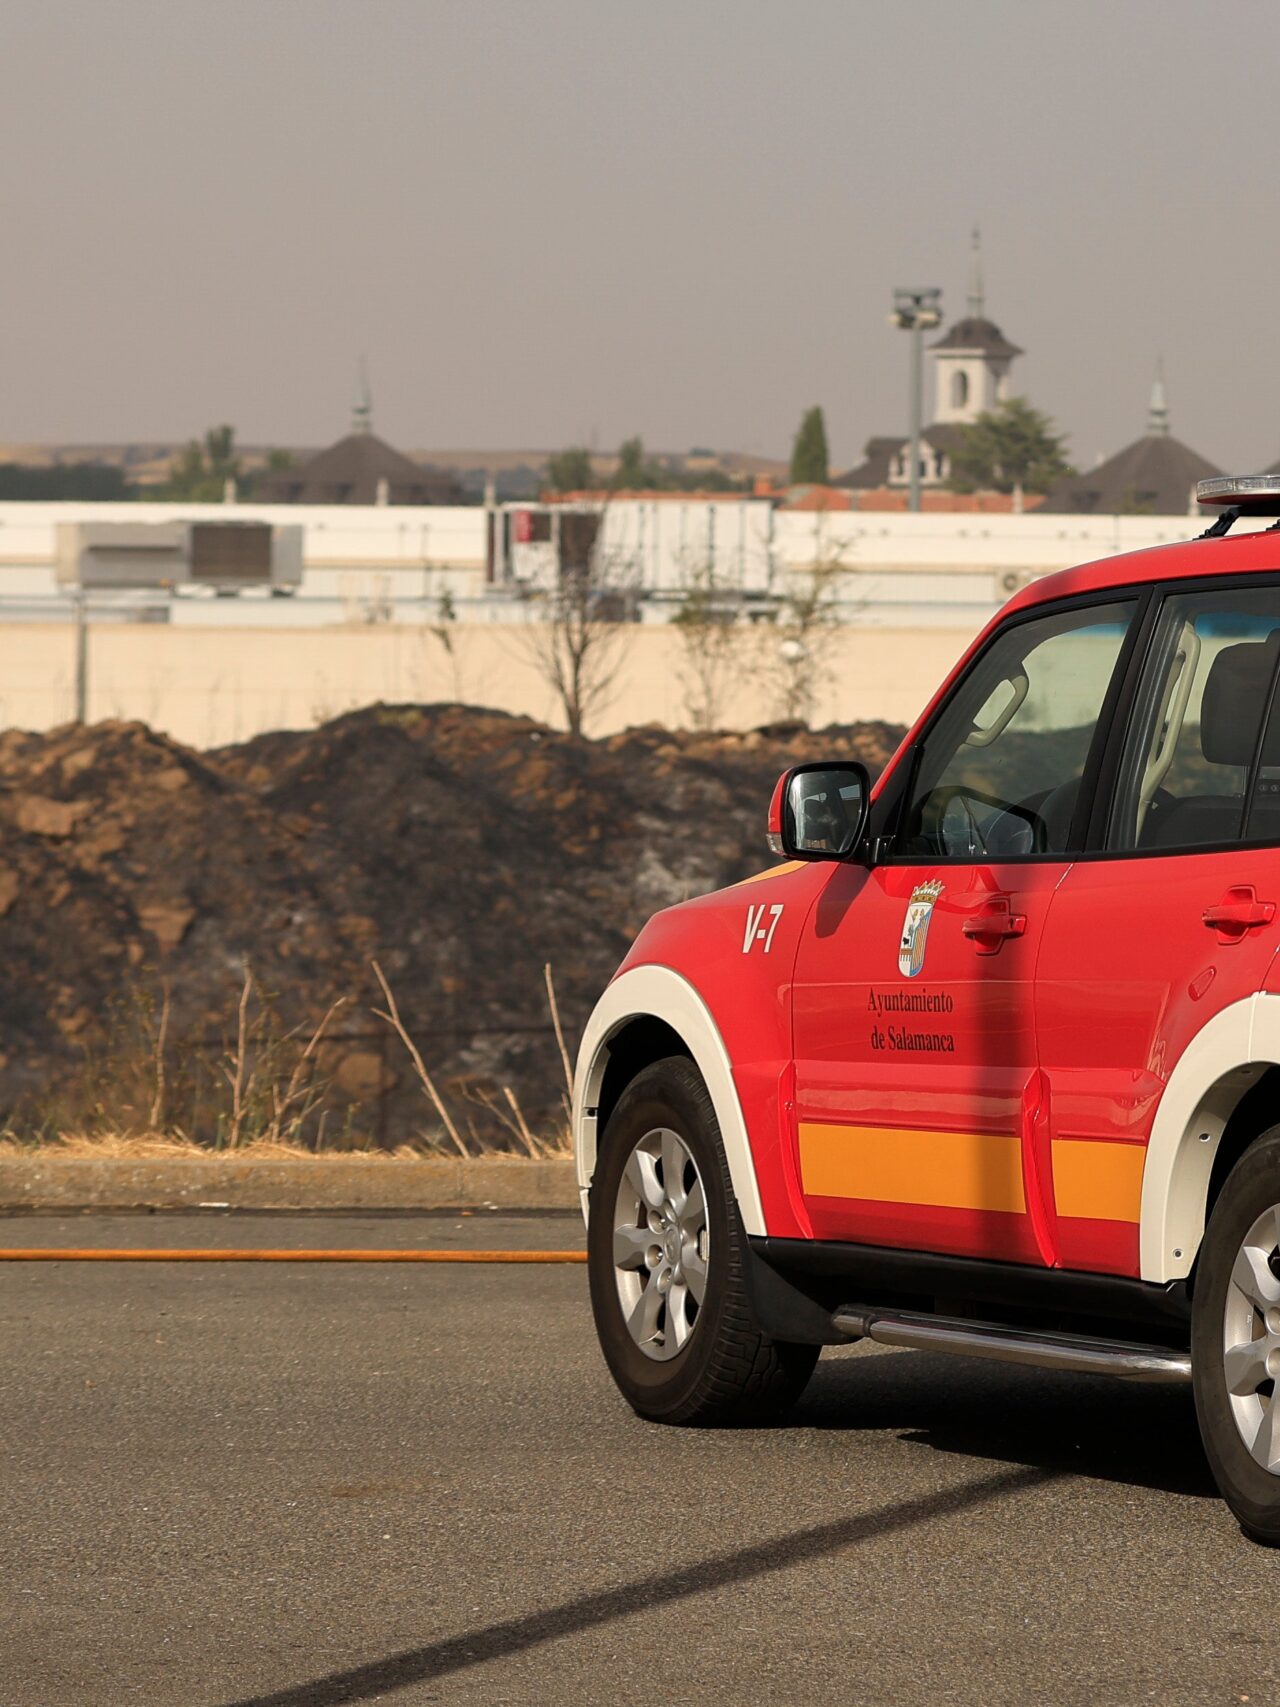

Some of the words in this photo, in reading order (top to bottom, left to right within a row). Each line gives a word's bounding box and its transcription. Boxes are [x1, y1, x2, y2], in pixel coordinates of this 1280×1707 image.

[742, 904, 784, 954] V-7
[868, 988, 953, 1016] Ayuntamiento
[871, 1026, 886, 1051] de
[888, 1027, 954, 1052] Salamanca
